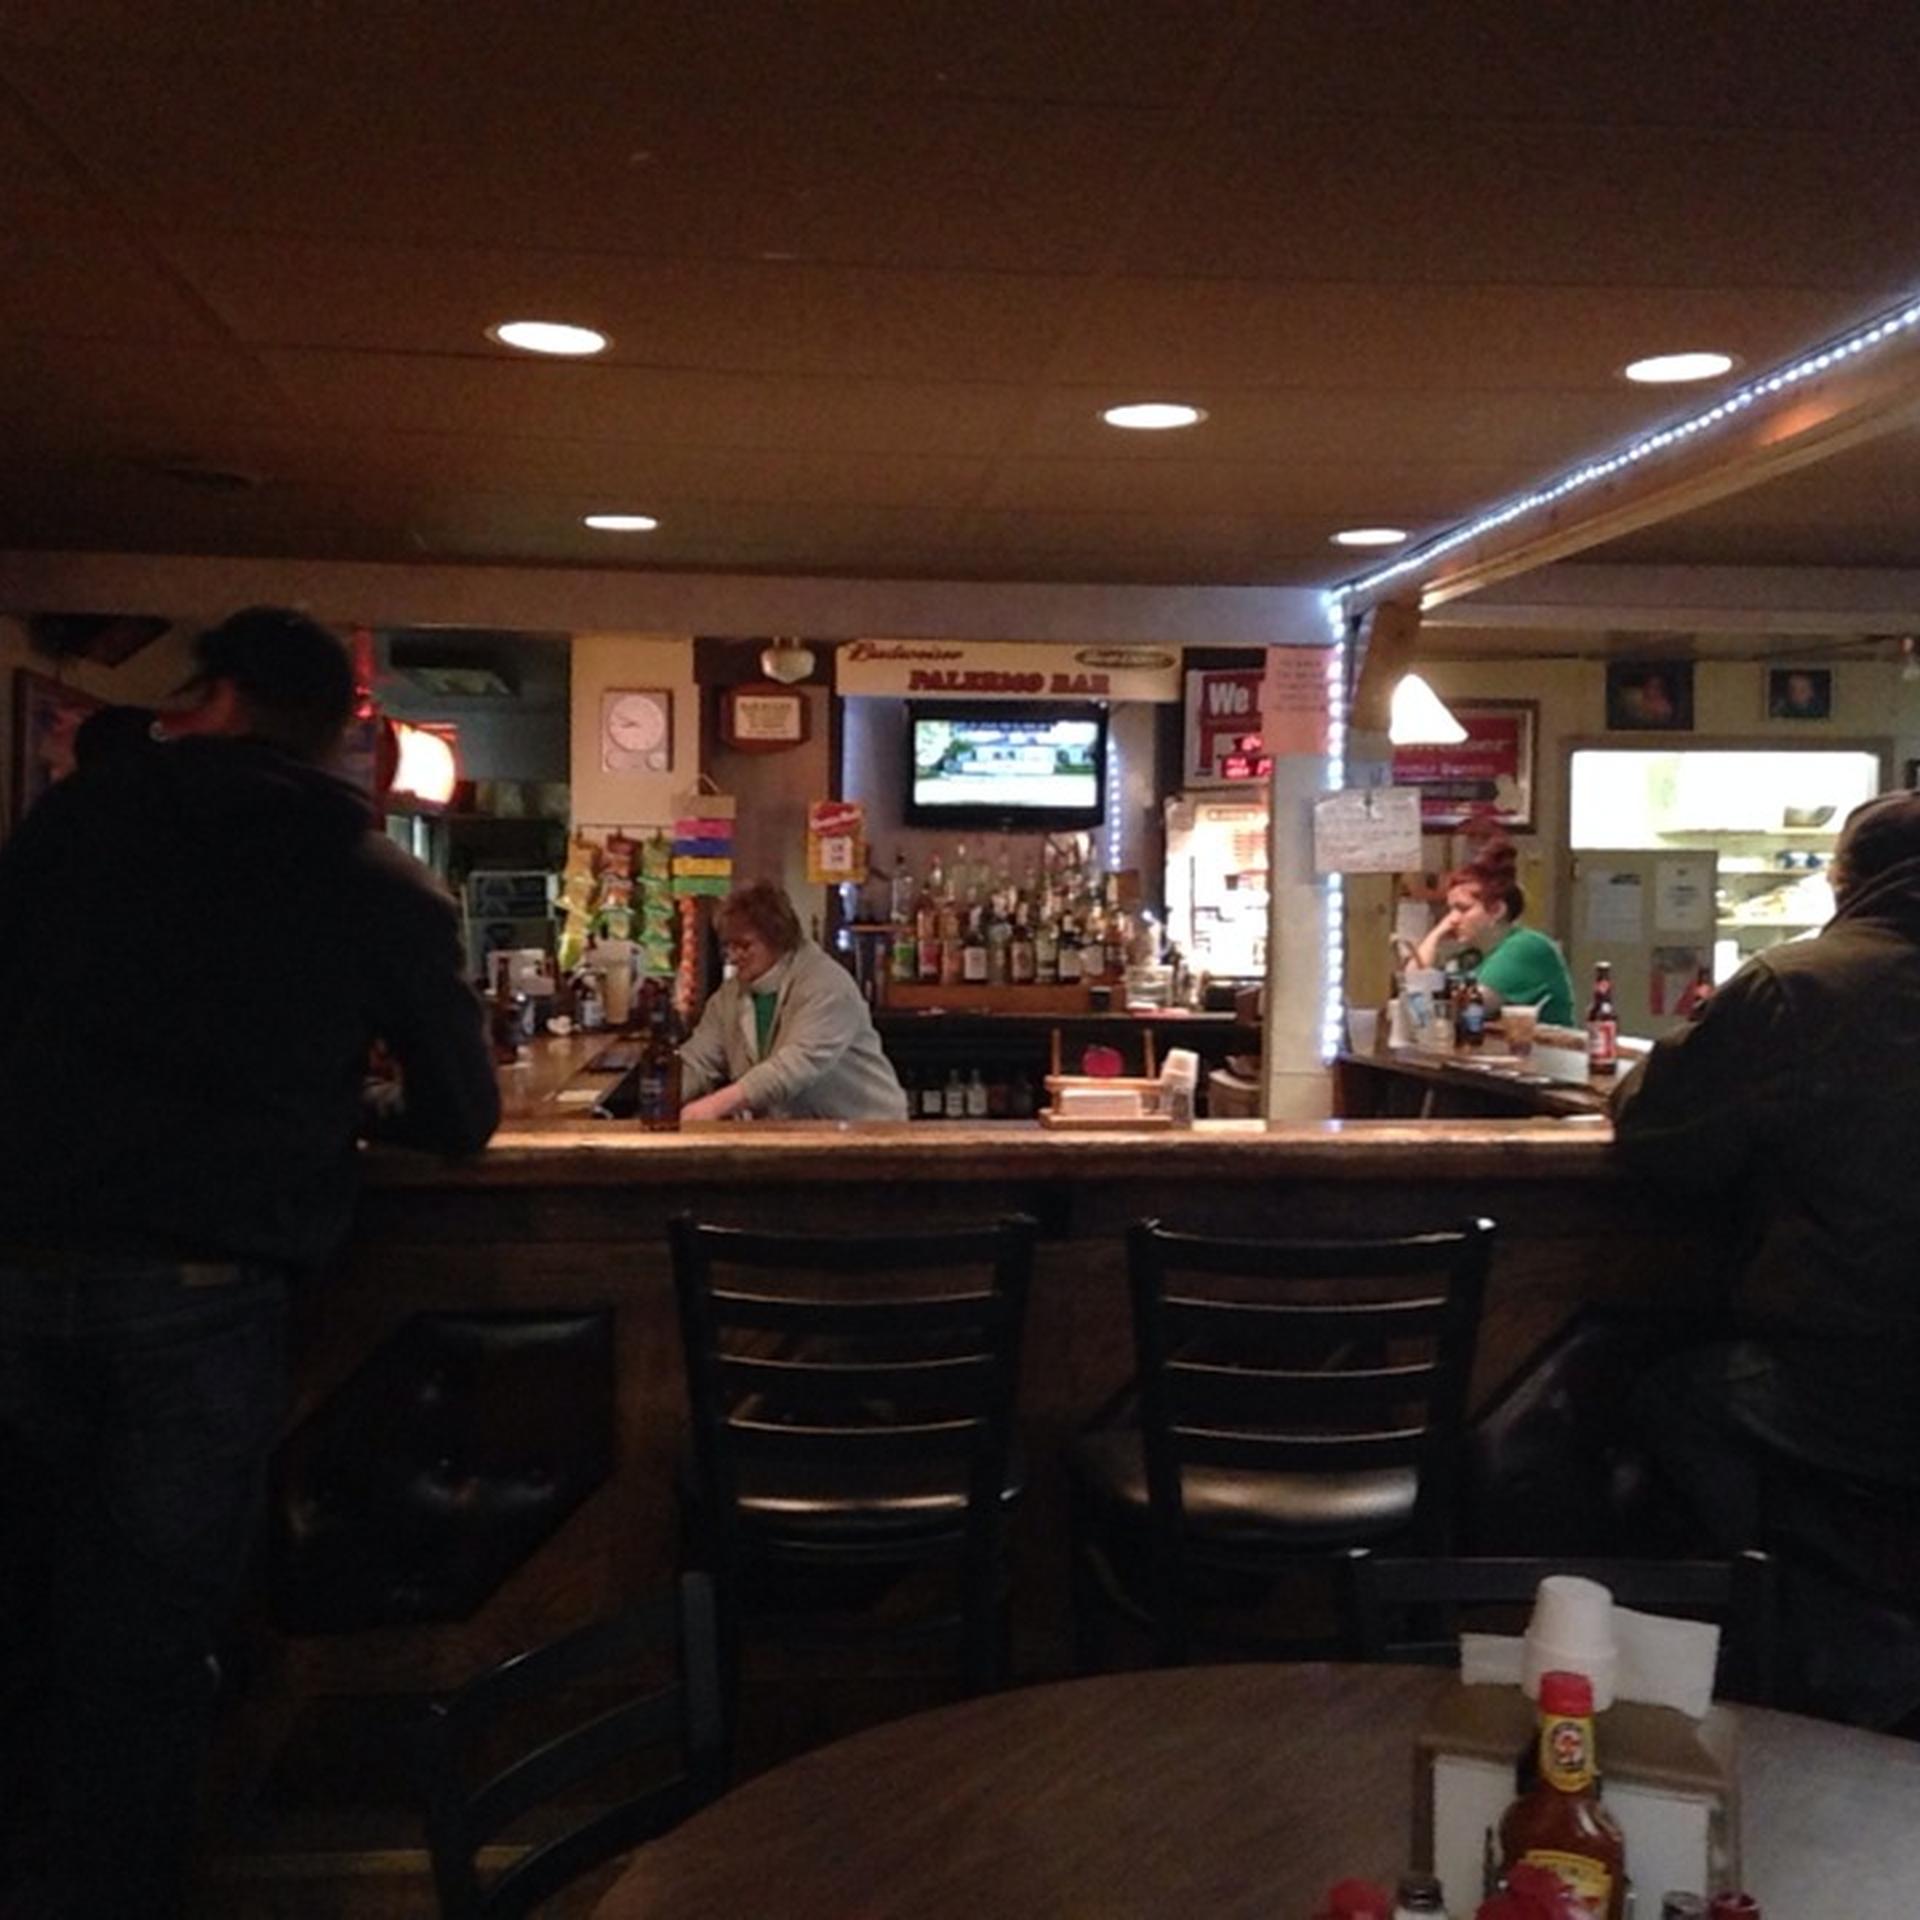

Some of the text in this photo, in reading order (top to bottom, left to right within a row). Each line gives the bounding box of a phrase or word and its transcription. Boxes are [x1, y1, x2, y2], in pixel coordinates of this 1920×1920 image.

[909, 670, 1109, 694] PALERMO BAR
[1209, 682, 1249, 715] We
